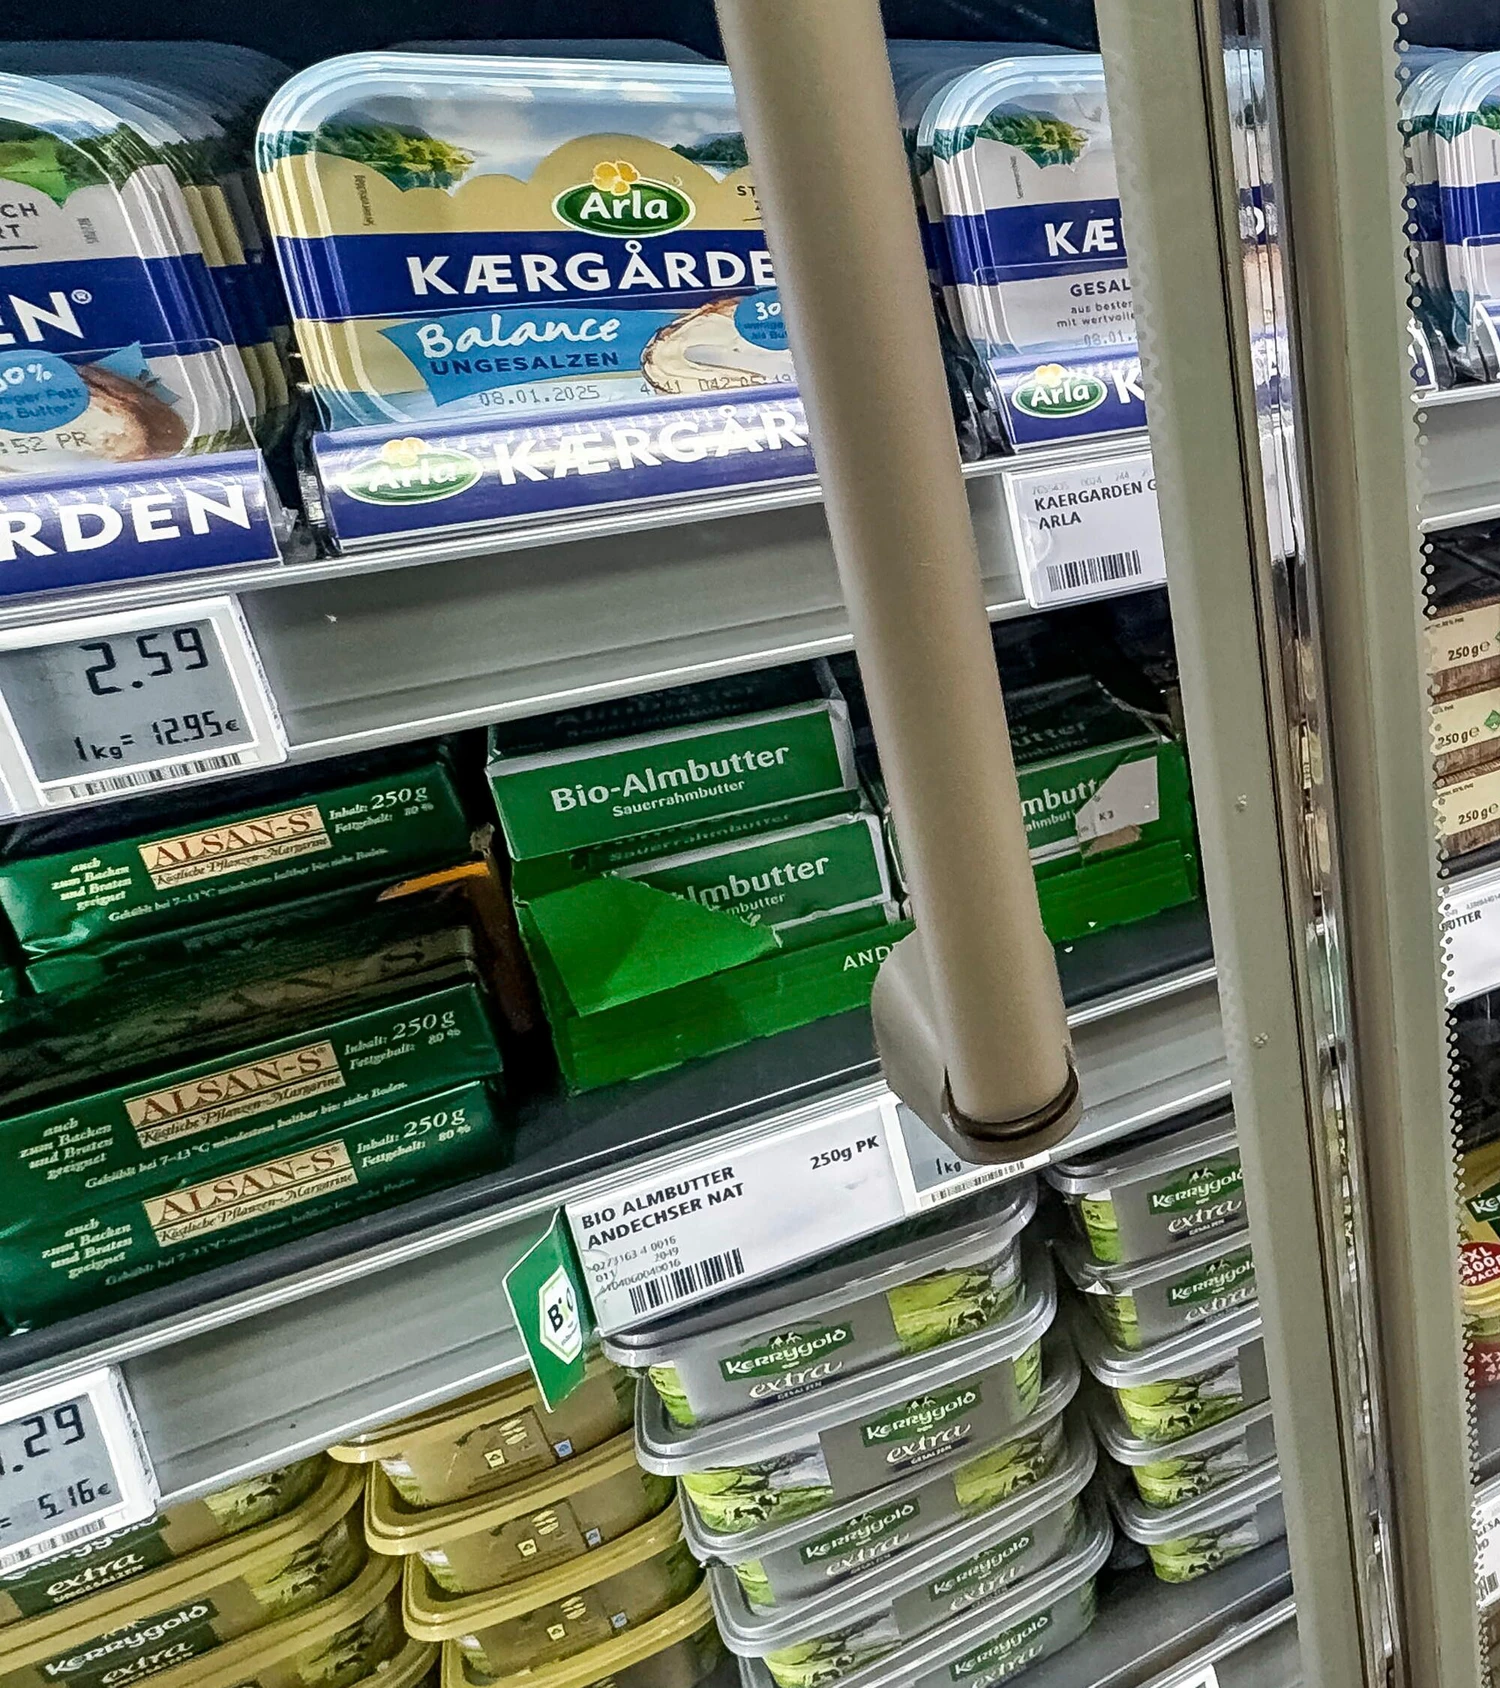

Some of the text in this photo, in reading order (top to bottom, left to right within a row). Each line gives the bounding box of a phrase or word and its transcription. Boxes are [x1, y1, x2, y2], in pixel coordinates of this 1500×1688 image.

[578, 186, 669, 222] Arla
[415, 314, 621, 360] Balance
[431, 350, 619, 378] UNGESALZEN
[479, 384, 601, 406] 08.01.2025
[1030, 385, 1092, 408] Arla
[56, 431, 91, 449] PR
[368, 457, 460, 491] Arla
[1034, 482, 1143, 513] KAERGARDEN
[1038, 510, 1083, 530] ARLA
[79, 627, 209, 695] 2.59
[550, 746, 791, 812] Bio-Almbutter
[612, 778, 746, 818] Sauerrahmbutter
[371, 788, 411, 812] 250
[392, 1012, 437, 1041] 250
[403, 1111, 448, 1139] 250
[581, 1135, 880, 1231] BIO ALMBUTTER 250g PK
[587, 1182, 745, 1250] ANDECHSER NAT
[1167, 1199, 1244, 1234] extra
[650, 1235, 677, 1252] 0016
[724, 1327, 848, 1376] Kerrygold
[749, 1360, 844, 1399] extra
[866, 1390, 978, 1441] Kerrygold
[887, 1422, 973, 1465] extra
[806, 1503, 916, 1561] Kerrygold
[46, 1553, 145, 1596] extra
[45, 1604, 210, 1676] Kerrygold
[101, 1641, 195, 1684] extra
